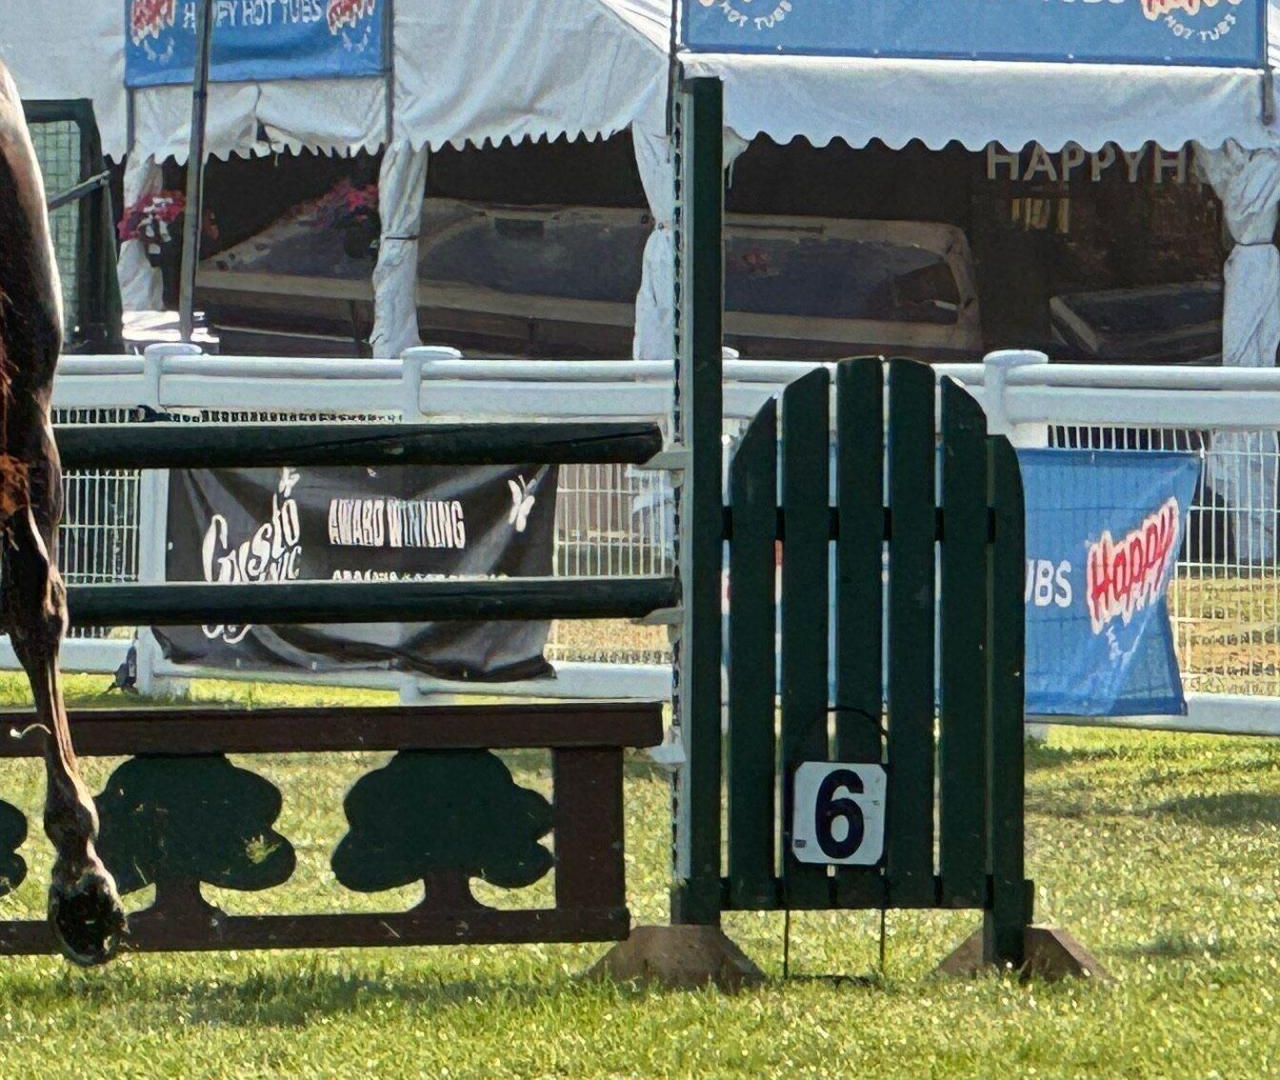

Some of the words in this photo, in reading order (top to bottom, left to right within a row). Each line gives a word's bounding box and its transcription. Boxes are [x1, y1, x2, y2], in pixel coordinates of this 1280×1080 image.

[241, 0, 276, 25] HOT
[328, 498, 385, 547] AWARD
[387, 498, 466, 549] WINNING
[1089, 500, 1177, 629] Happy
[815, 769, 864, 859] 6
